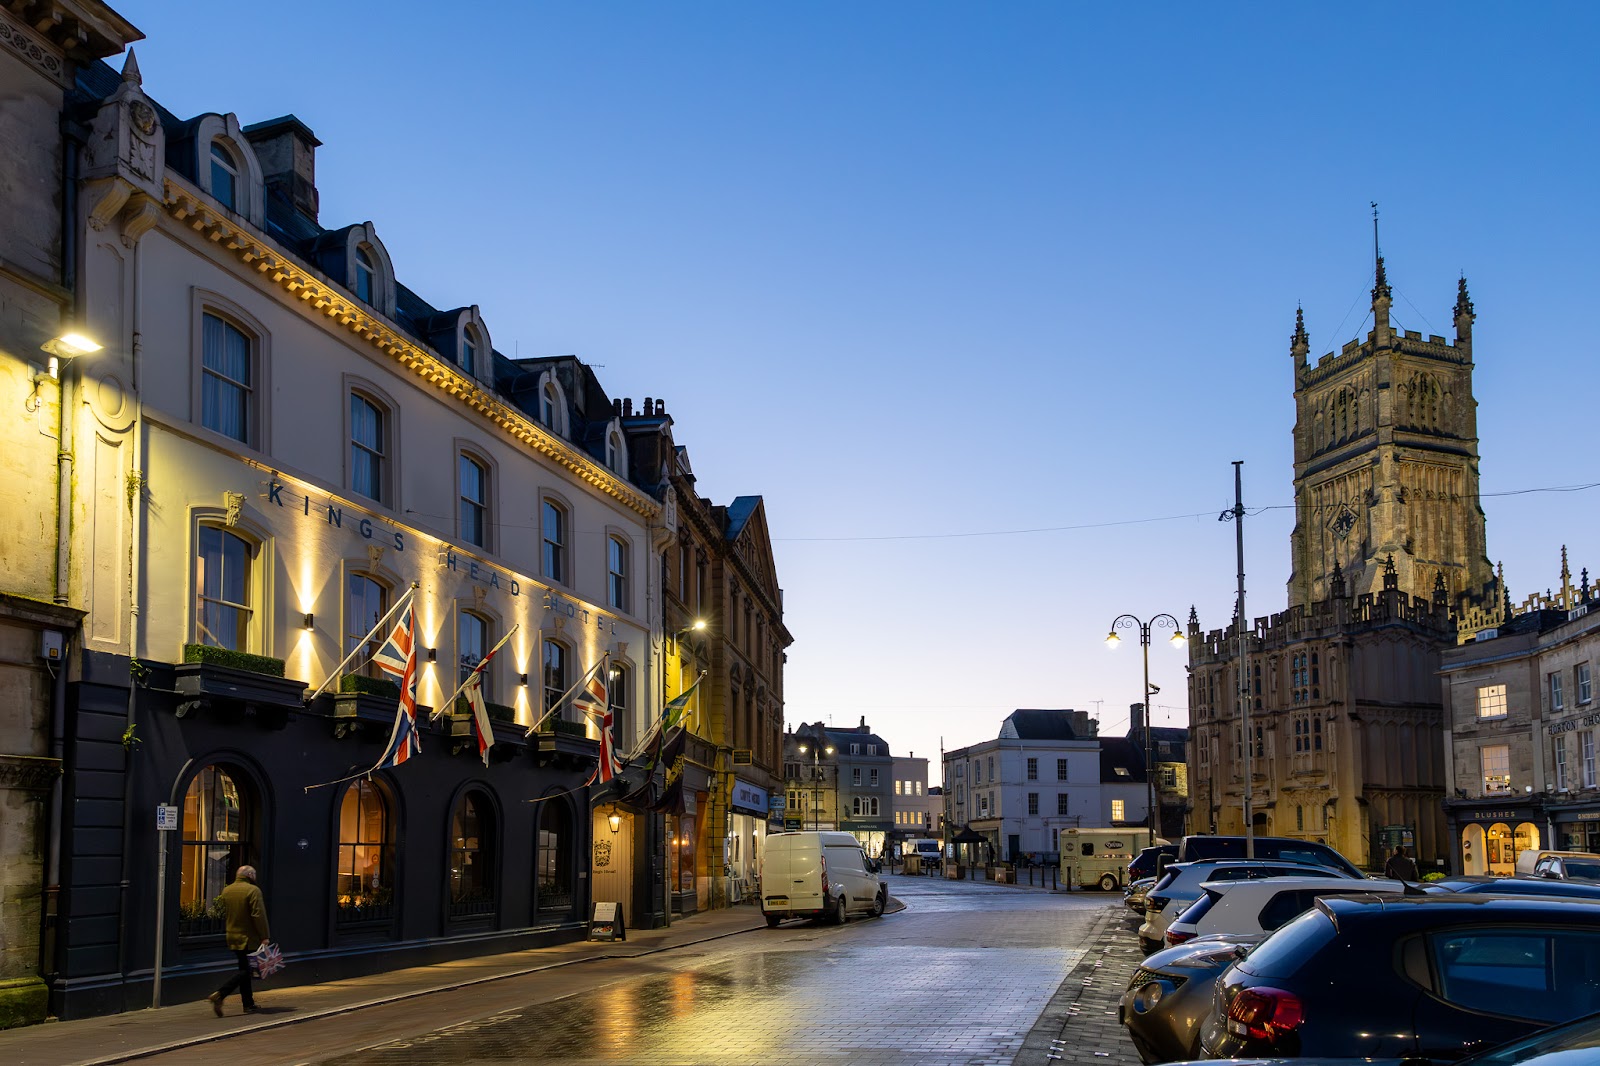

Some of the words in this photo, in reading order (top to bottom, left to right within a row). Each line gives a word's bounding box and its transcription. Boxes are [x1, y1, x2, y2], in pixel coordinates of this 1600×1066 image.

[268, 481, 404, 552] KINGS
[447, 552, 520, 597] HEAD
[551, 596, 616, 636] HOTEL
[1475, 811, 1515, 819] BLUSHES
